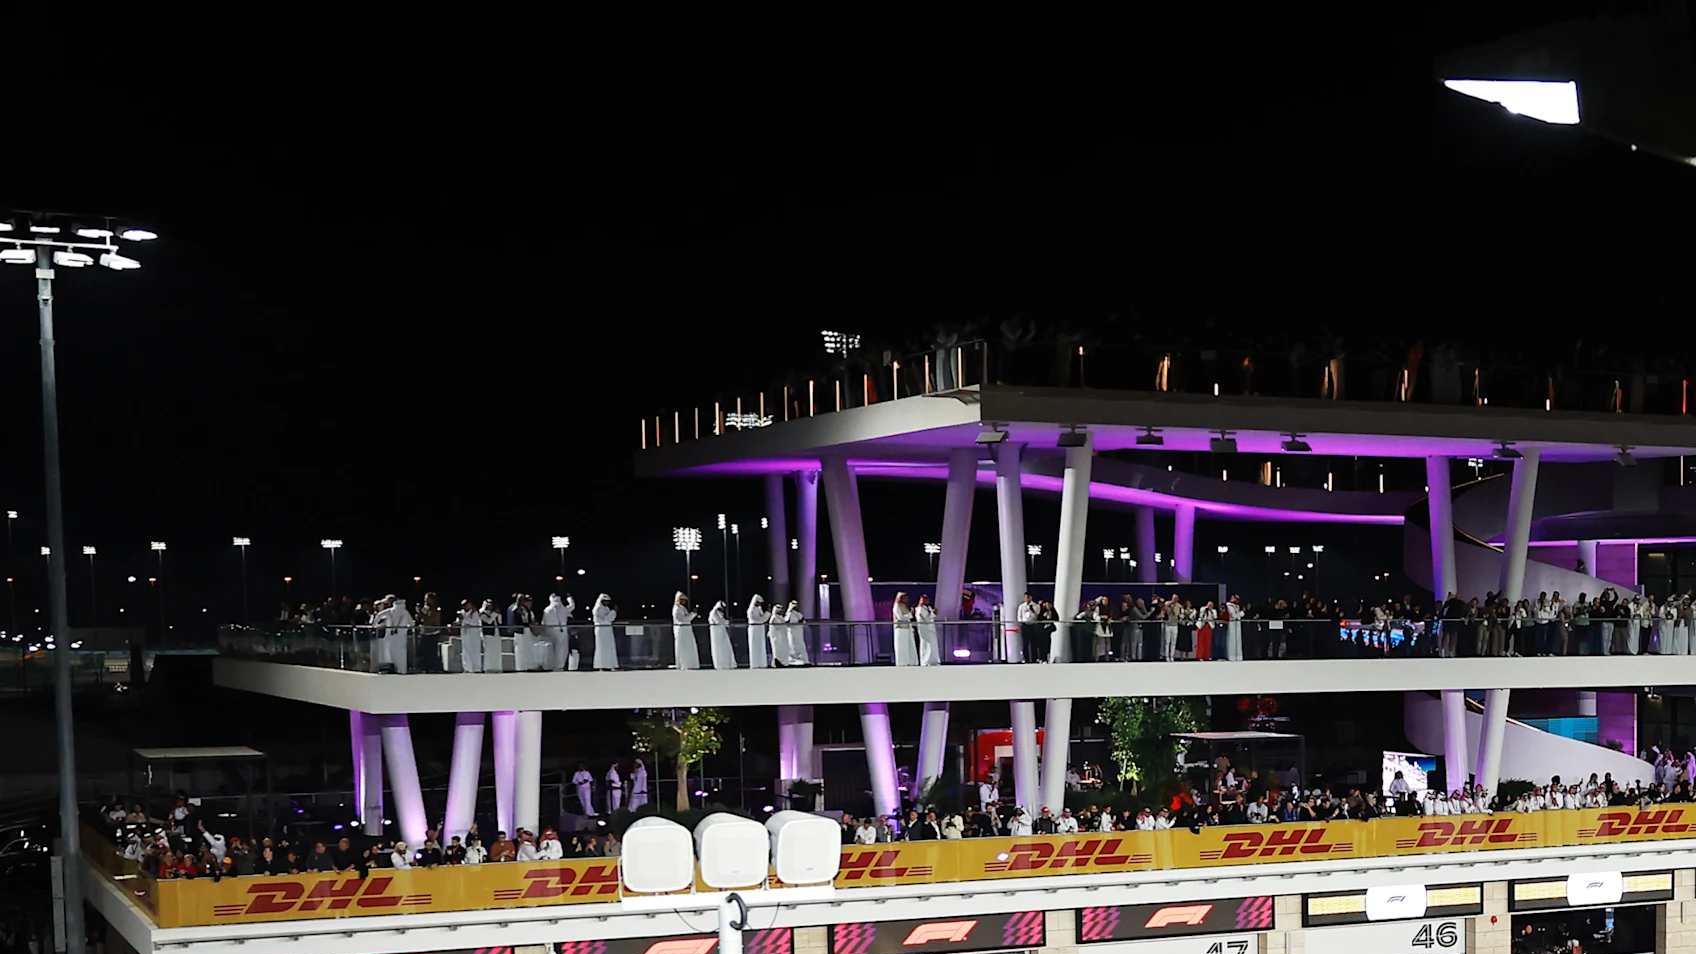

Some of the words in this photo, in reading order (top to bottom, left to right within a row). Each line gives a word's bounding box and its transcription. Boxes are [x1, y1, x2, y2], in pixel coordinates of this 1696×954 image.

[1416, 818, 1518, 847] DHL
[1595, 809, 1690, 836] DHL
[1007, 839, 1130, 870] DHL
[1221, 828, 1334, 858] DHL
[834, 850, 909, 880] HL
[246, 877, 402, 915] DHL
[518, 866, 620, 898] DH
[1144, 904, 1213, 929] F1
[902, 919, 978, 946] F1
[1411, 921, 1458, 949] 46
